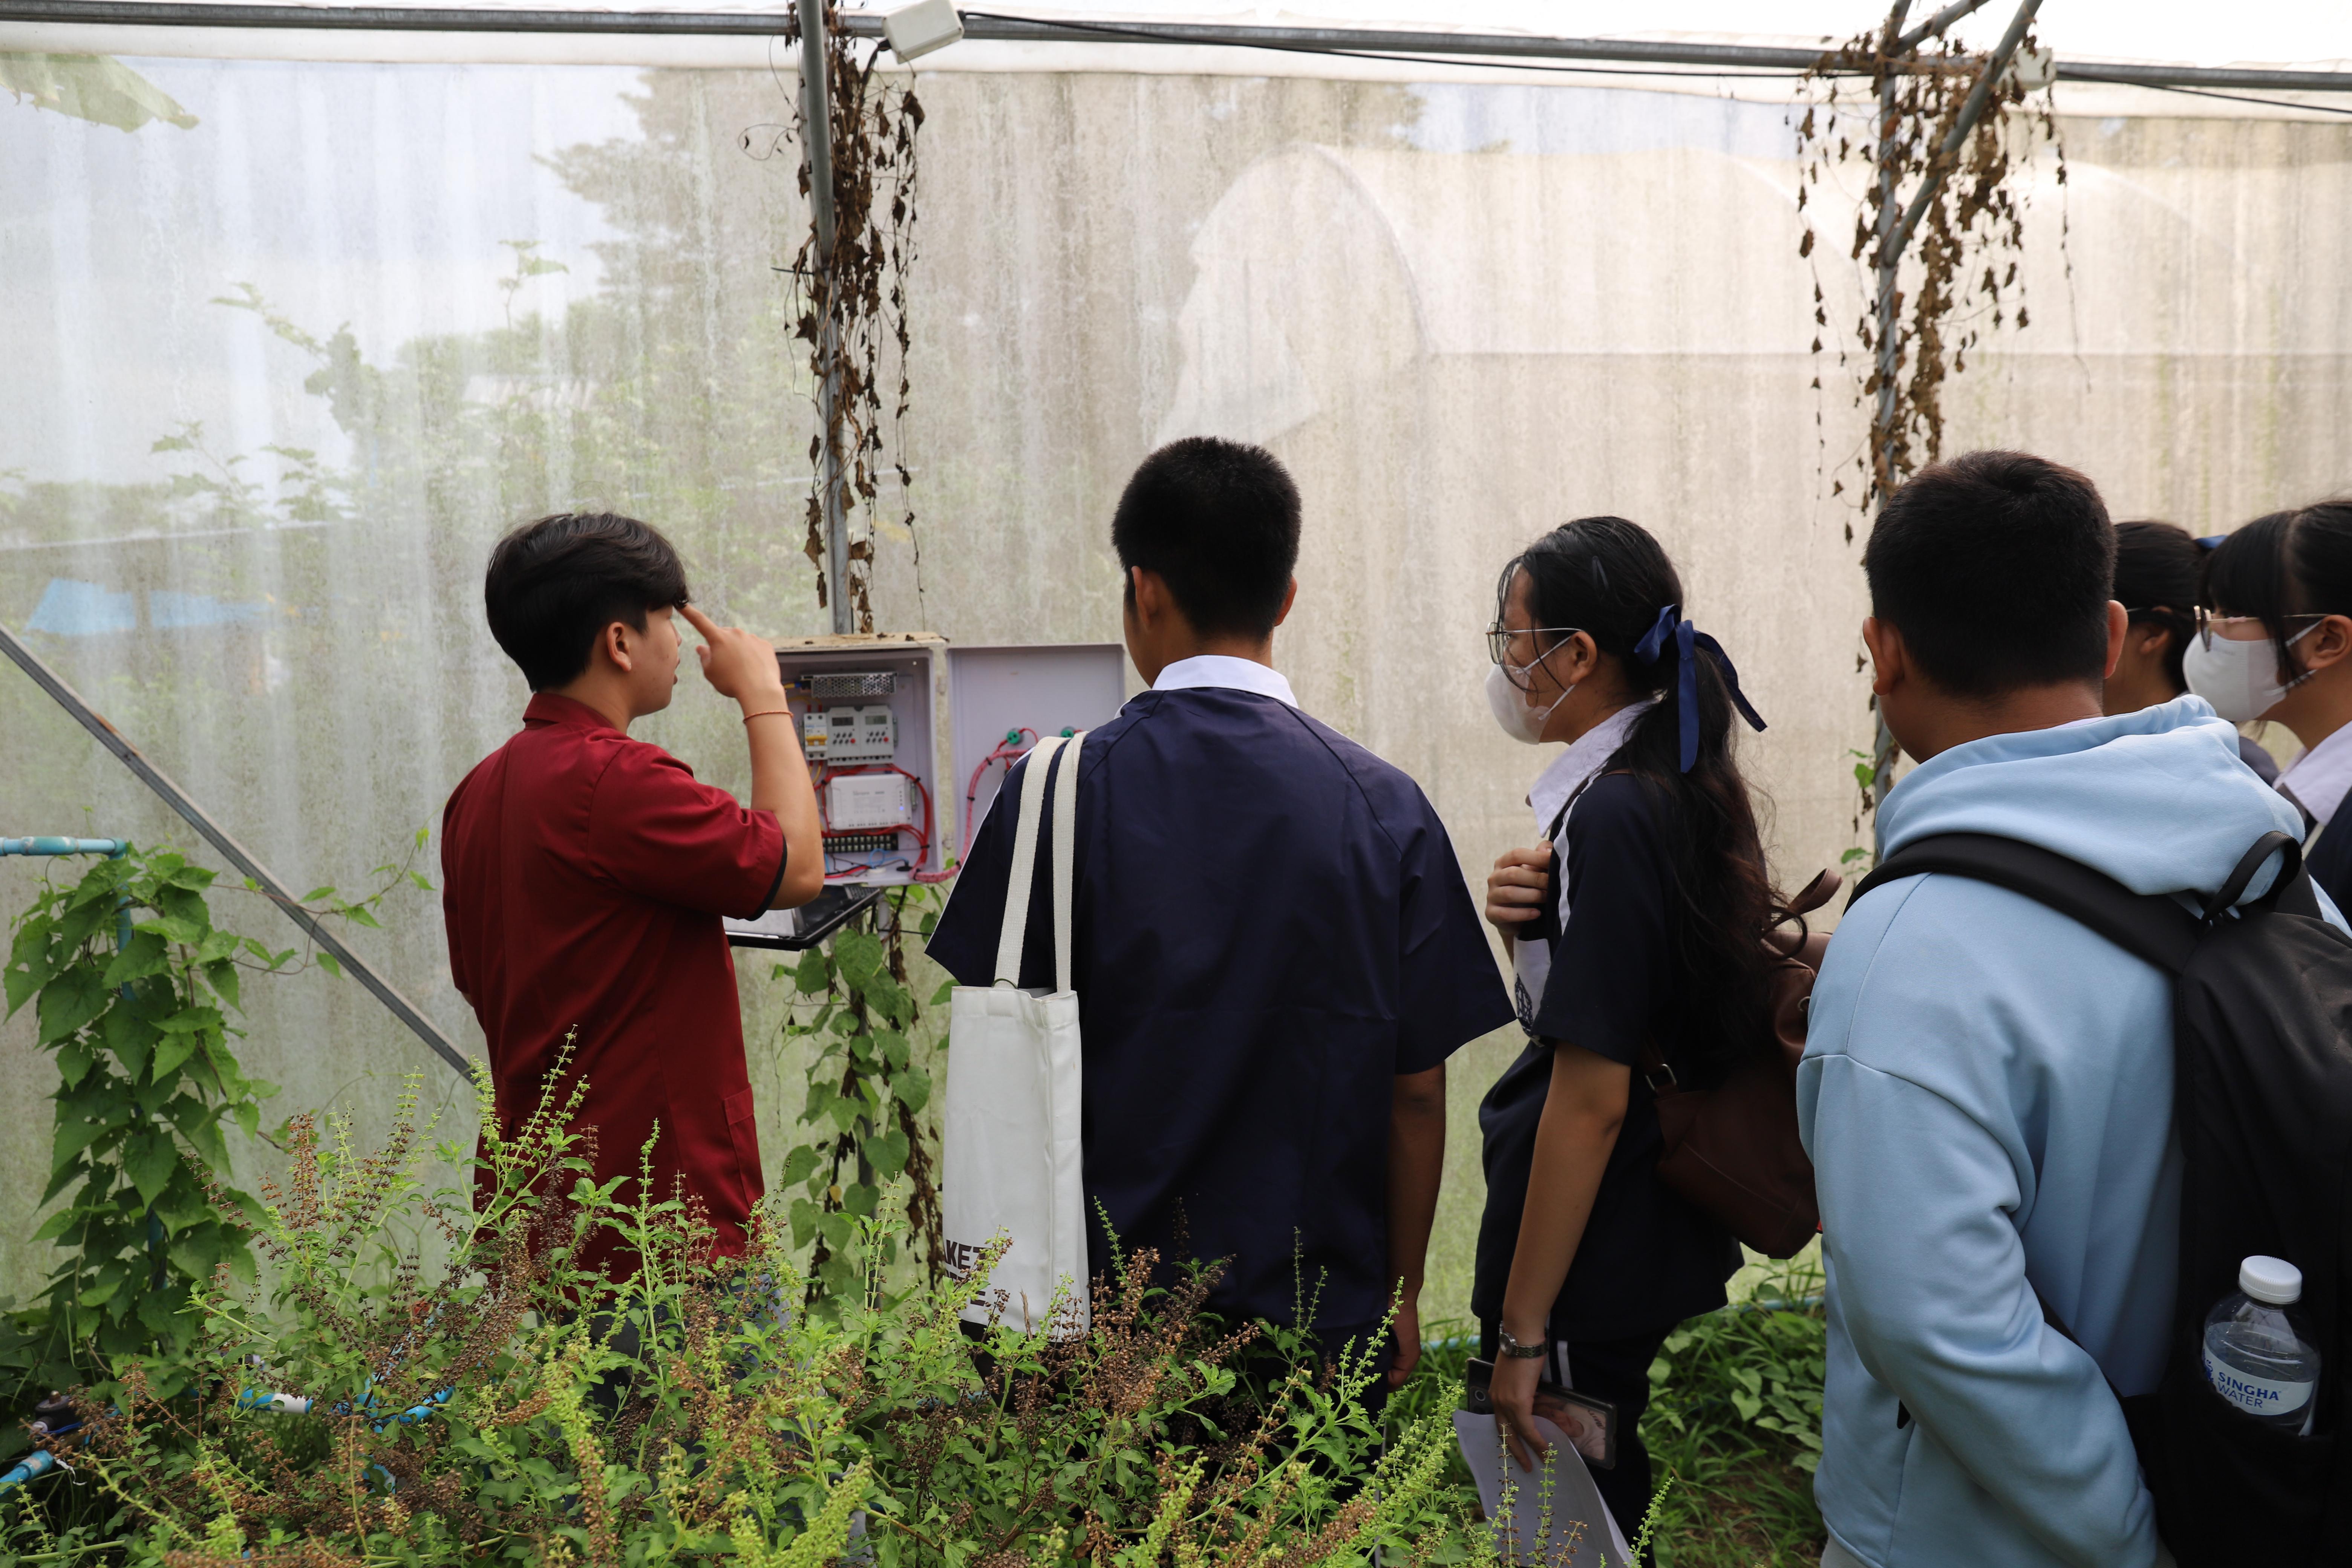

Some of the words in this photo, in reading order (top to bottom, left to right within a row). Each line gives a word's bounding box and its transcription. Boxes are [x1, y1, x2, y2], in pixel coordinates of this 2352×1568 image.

[943, 1239, 992, 1271] KET
[2218, 1372, 2279, 1401] SINGHA
[2218, 1381, 2263, 1408] WATER
